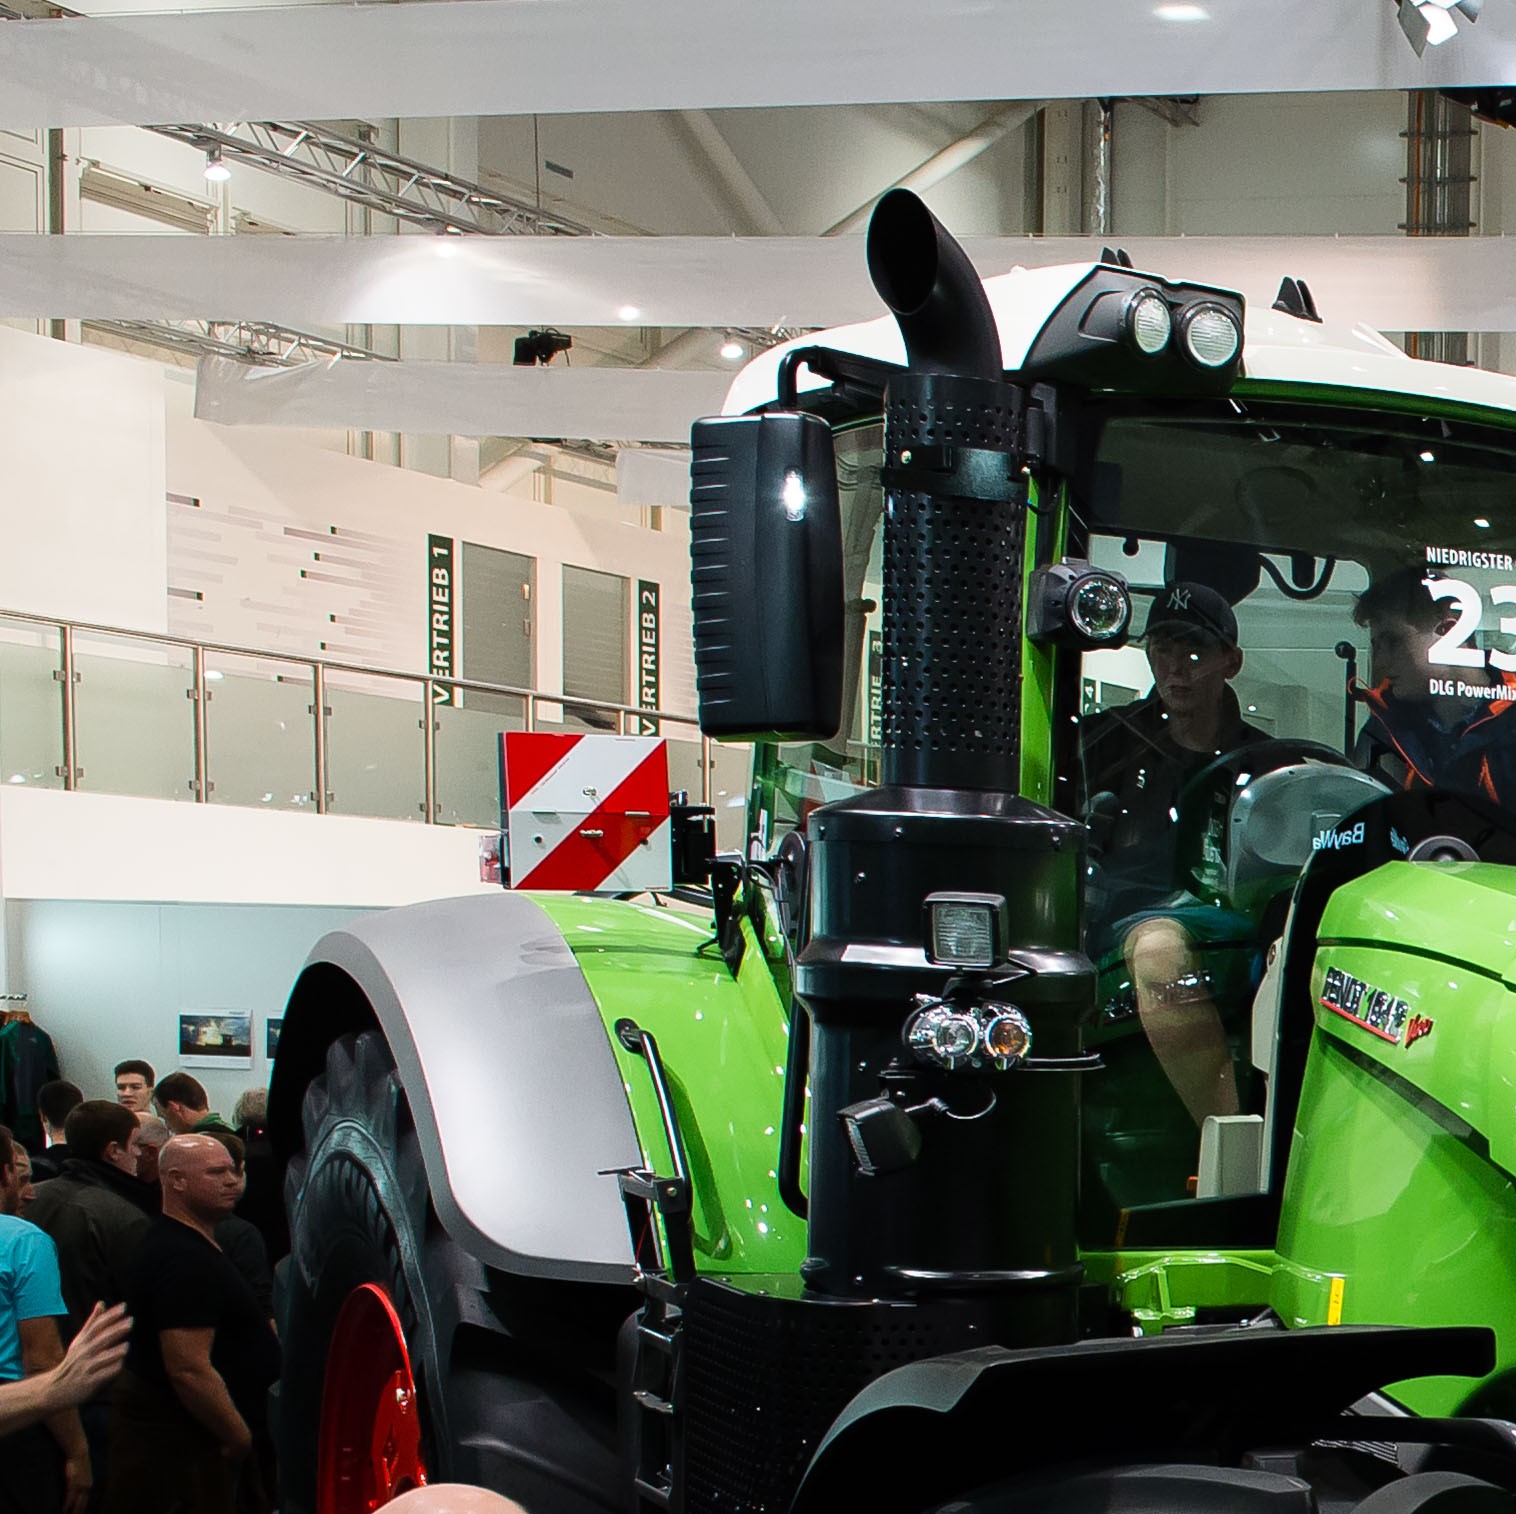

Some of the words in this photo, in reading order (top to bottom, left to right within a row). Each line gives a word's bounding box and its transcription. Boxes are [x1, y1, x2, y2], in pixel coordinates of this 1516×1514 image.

[433, 546, 449, 557] 1
[1426, 547, 1513, 571] NIEDRIGSTER
[642, 590, 656, 607] 2
[1429, 679, 1455, 696] DLG
